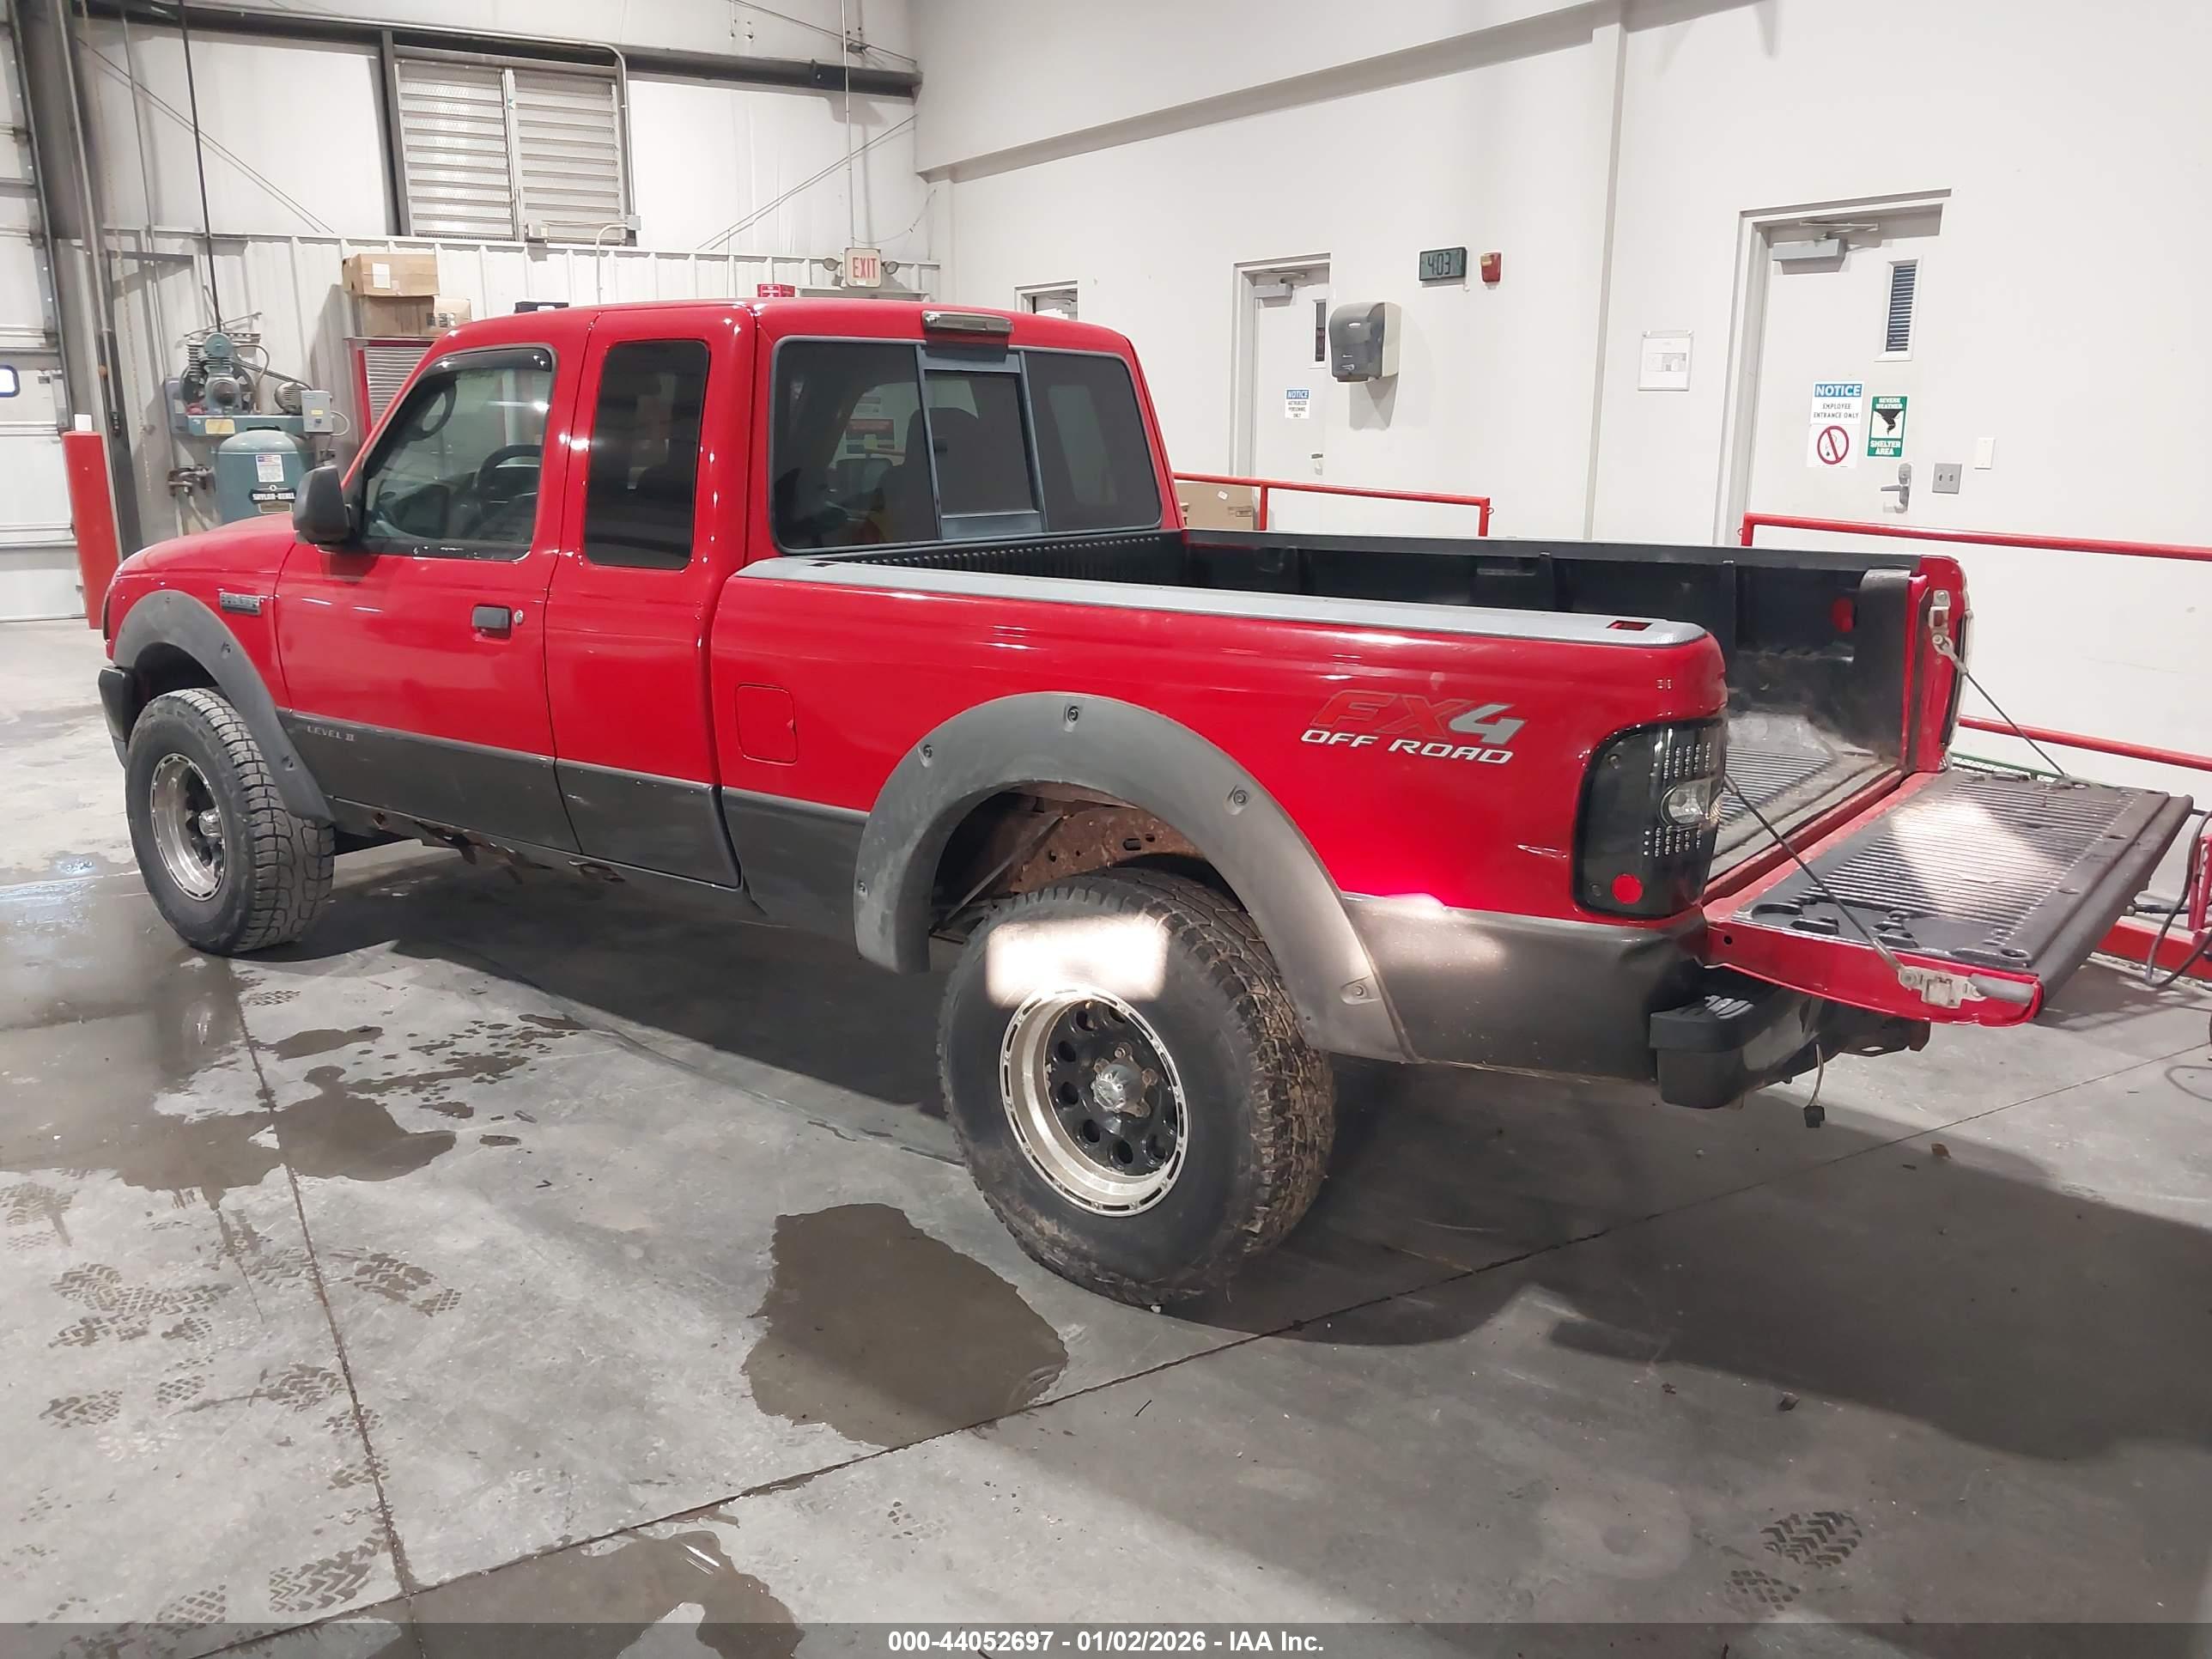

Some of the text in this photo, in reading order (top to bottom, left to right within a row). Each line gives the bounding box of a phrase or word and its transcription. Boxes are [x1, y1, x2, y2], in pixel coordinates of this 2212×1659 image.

[853, 258, 877, 278] EXIT
[1287, 390, 1309, 398] NOTICE
[1815, 385, 1862, 397] NOTICE
[1869, 440, 1901, 448] SHELTER
[1310, 689, 1528, 745] FX4
[307, 726, 343, 739] LEVEL
[1300, 729, 1514, 765] OFF ROAD
